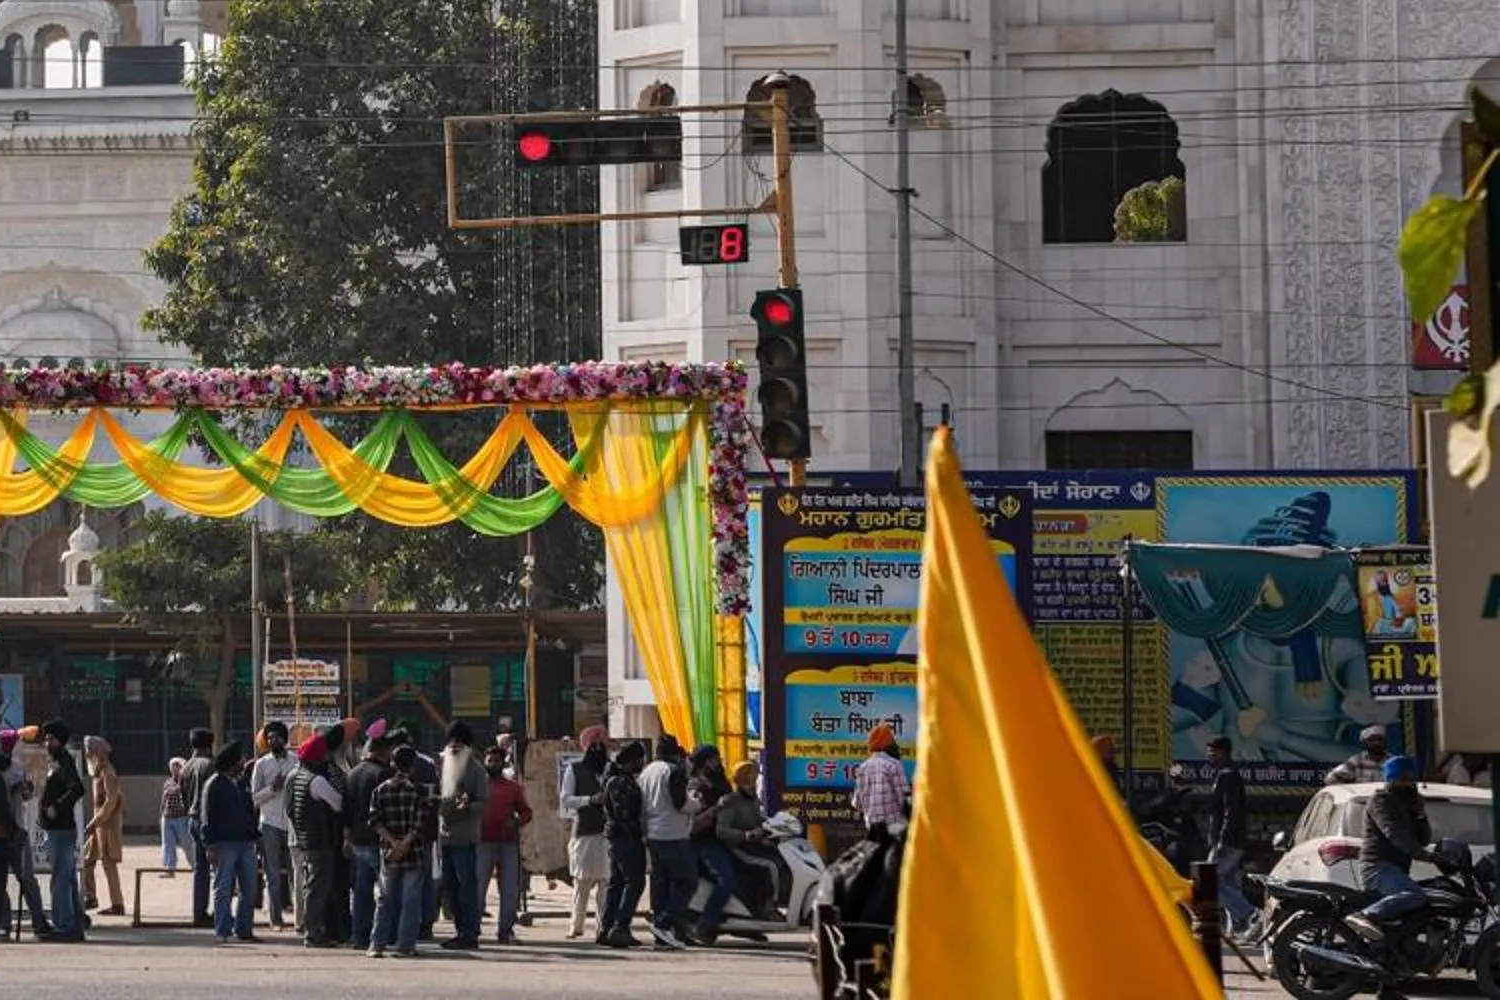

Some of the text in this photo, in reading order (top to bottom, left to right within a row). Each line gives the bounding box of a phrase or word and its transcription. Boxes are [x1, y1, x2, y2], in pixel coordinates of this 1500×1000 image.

[720, 228, 742, 260] 8
[1065, 480, 1121, 500] ਸੋਹਾਣਾ
[800, 509, 924, 530] ਮਹਾਨ ਗੁਰਮਤਿ
[790, 555, 922, 579] ਗਿਆਨੀ ਪਿੰਦਰਪਾਲ
[829, 583, 884, 605] ਸਿੰਘ ਜੀ
[805, 627, 890, 647] 9 ਤੋਂ 10 ਰਾਤ
[1368, 644, 1403, 680] ਜੀ
[840, 691, 874, 706] ਬਾਬਾ
[812, 713, 842, 732] ਬੰਤਾ
[807, 763, 818, 779] 9
